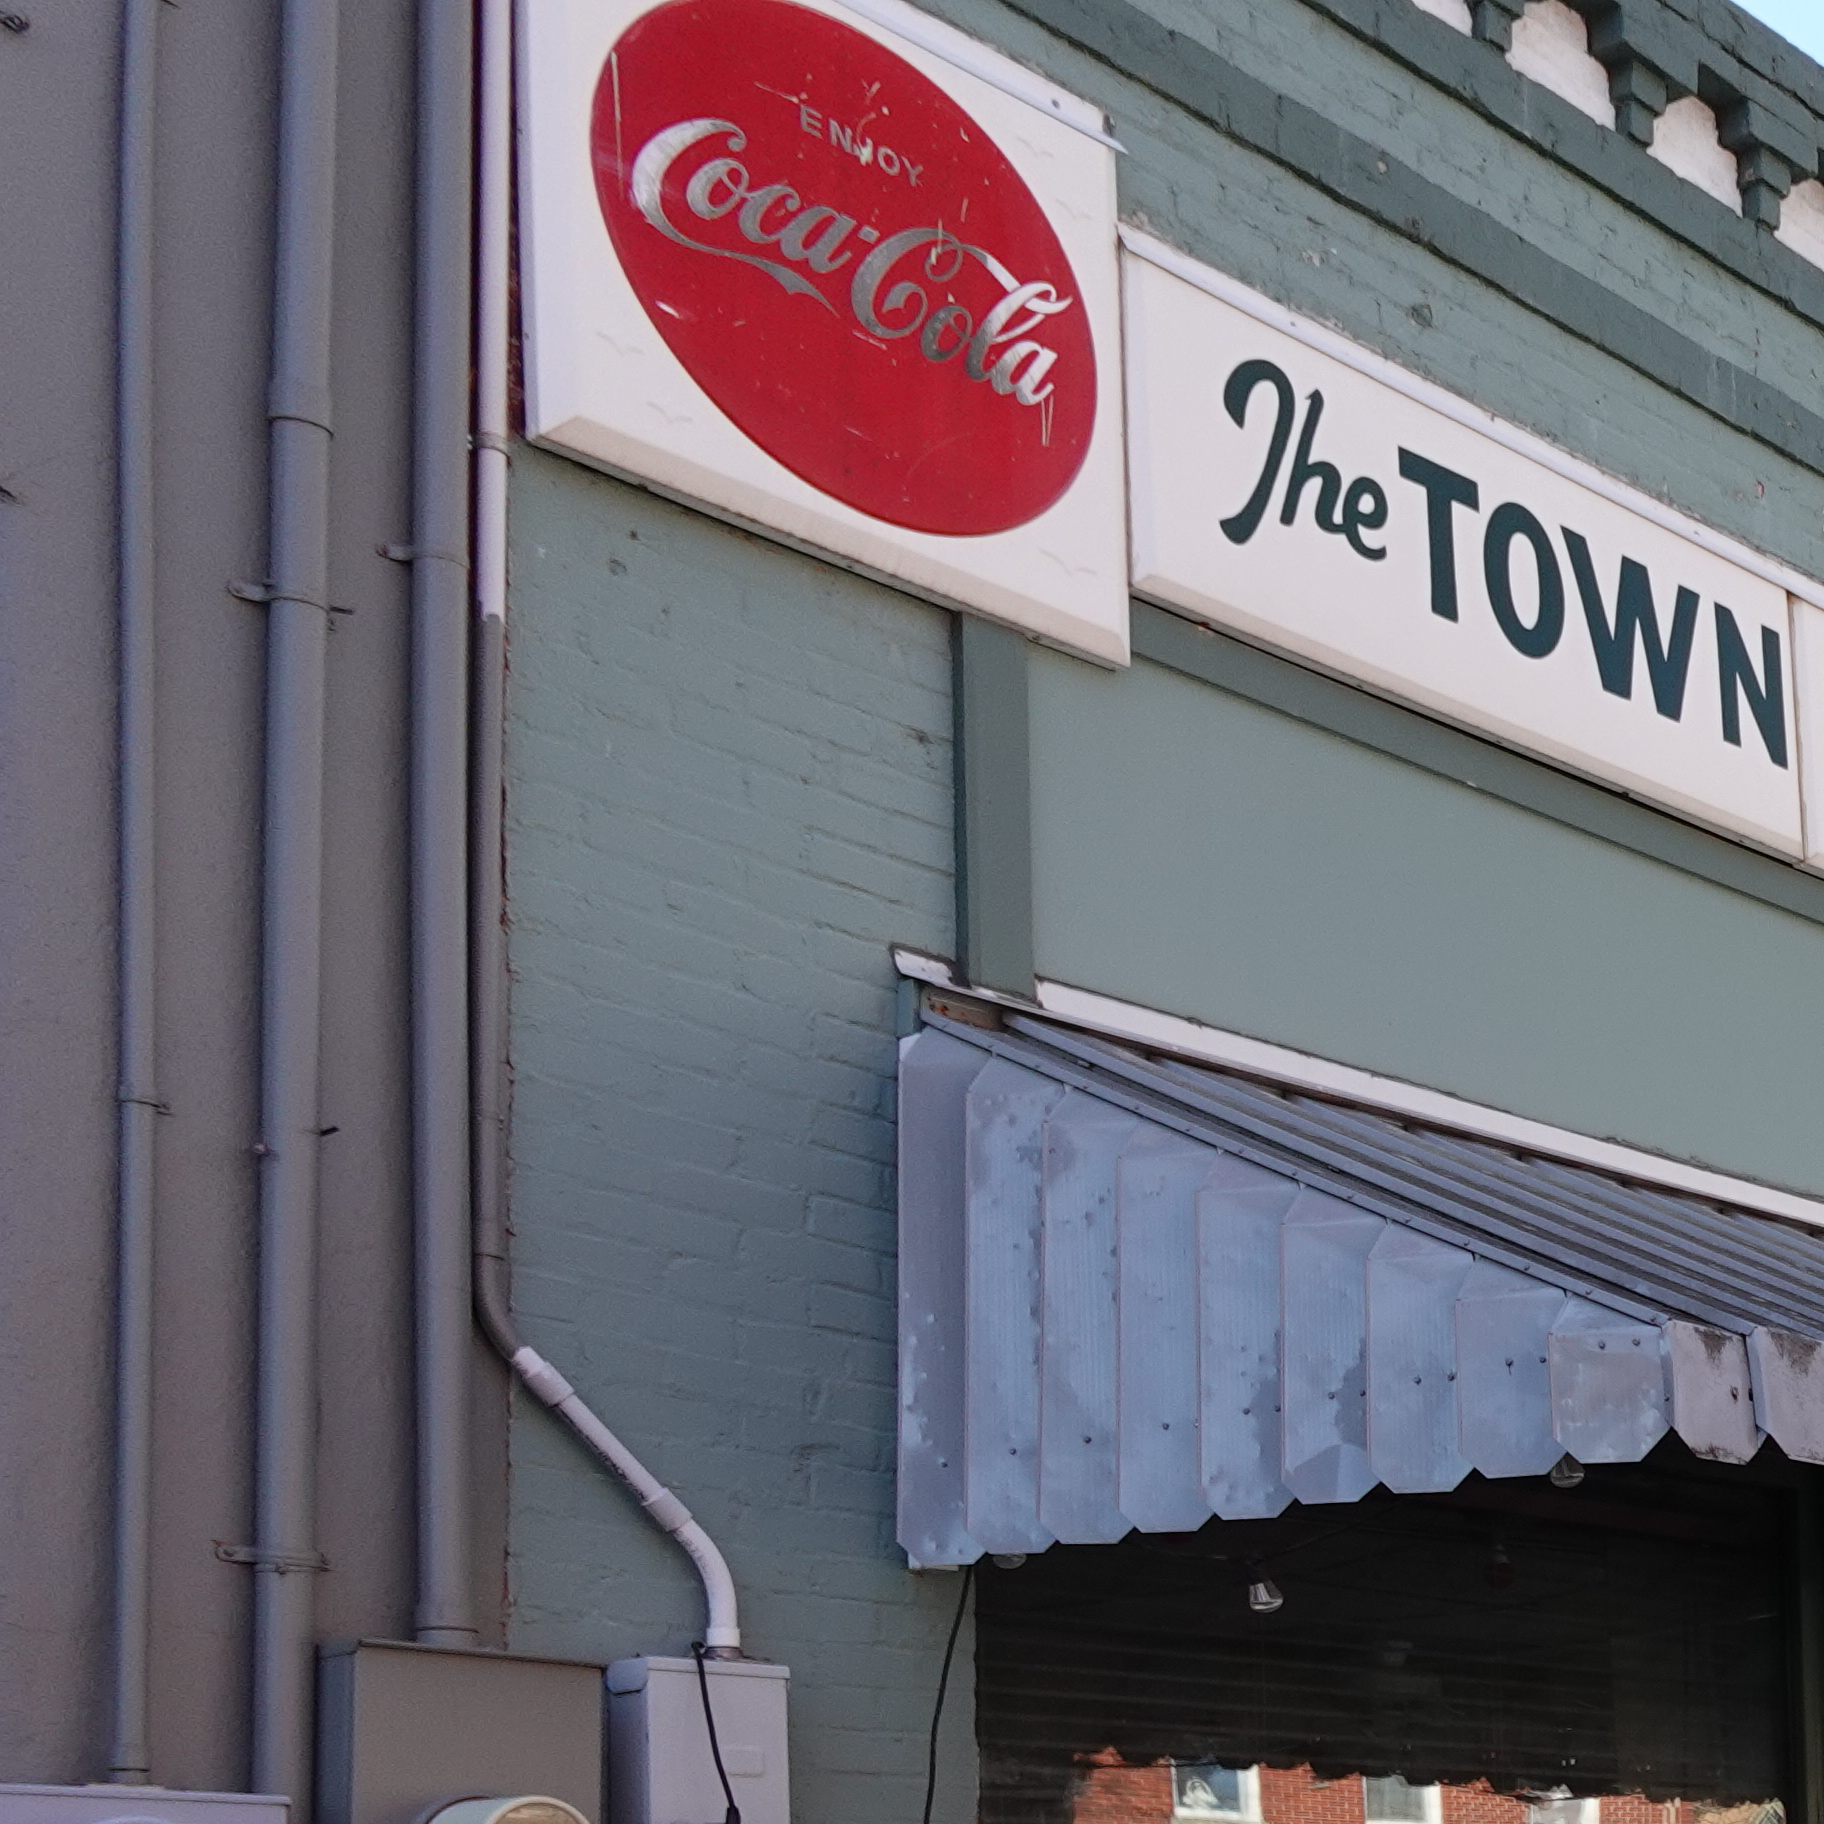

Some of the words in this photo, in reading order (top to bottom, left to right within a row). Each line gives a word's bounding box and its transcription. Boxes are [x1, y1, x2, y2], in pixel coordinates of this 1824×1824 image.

[631, 117, 1073, 406] Coca-Cola
[800, 104, 924, 188] ENJOY
[1219, 357, 1388, 562] The
[1397, 445, 1788, 771] TOWN
